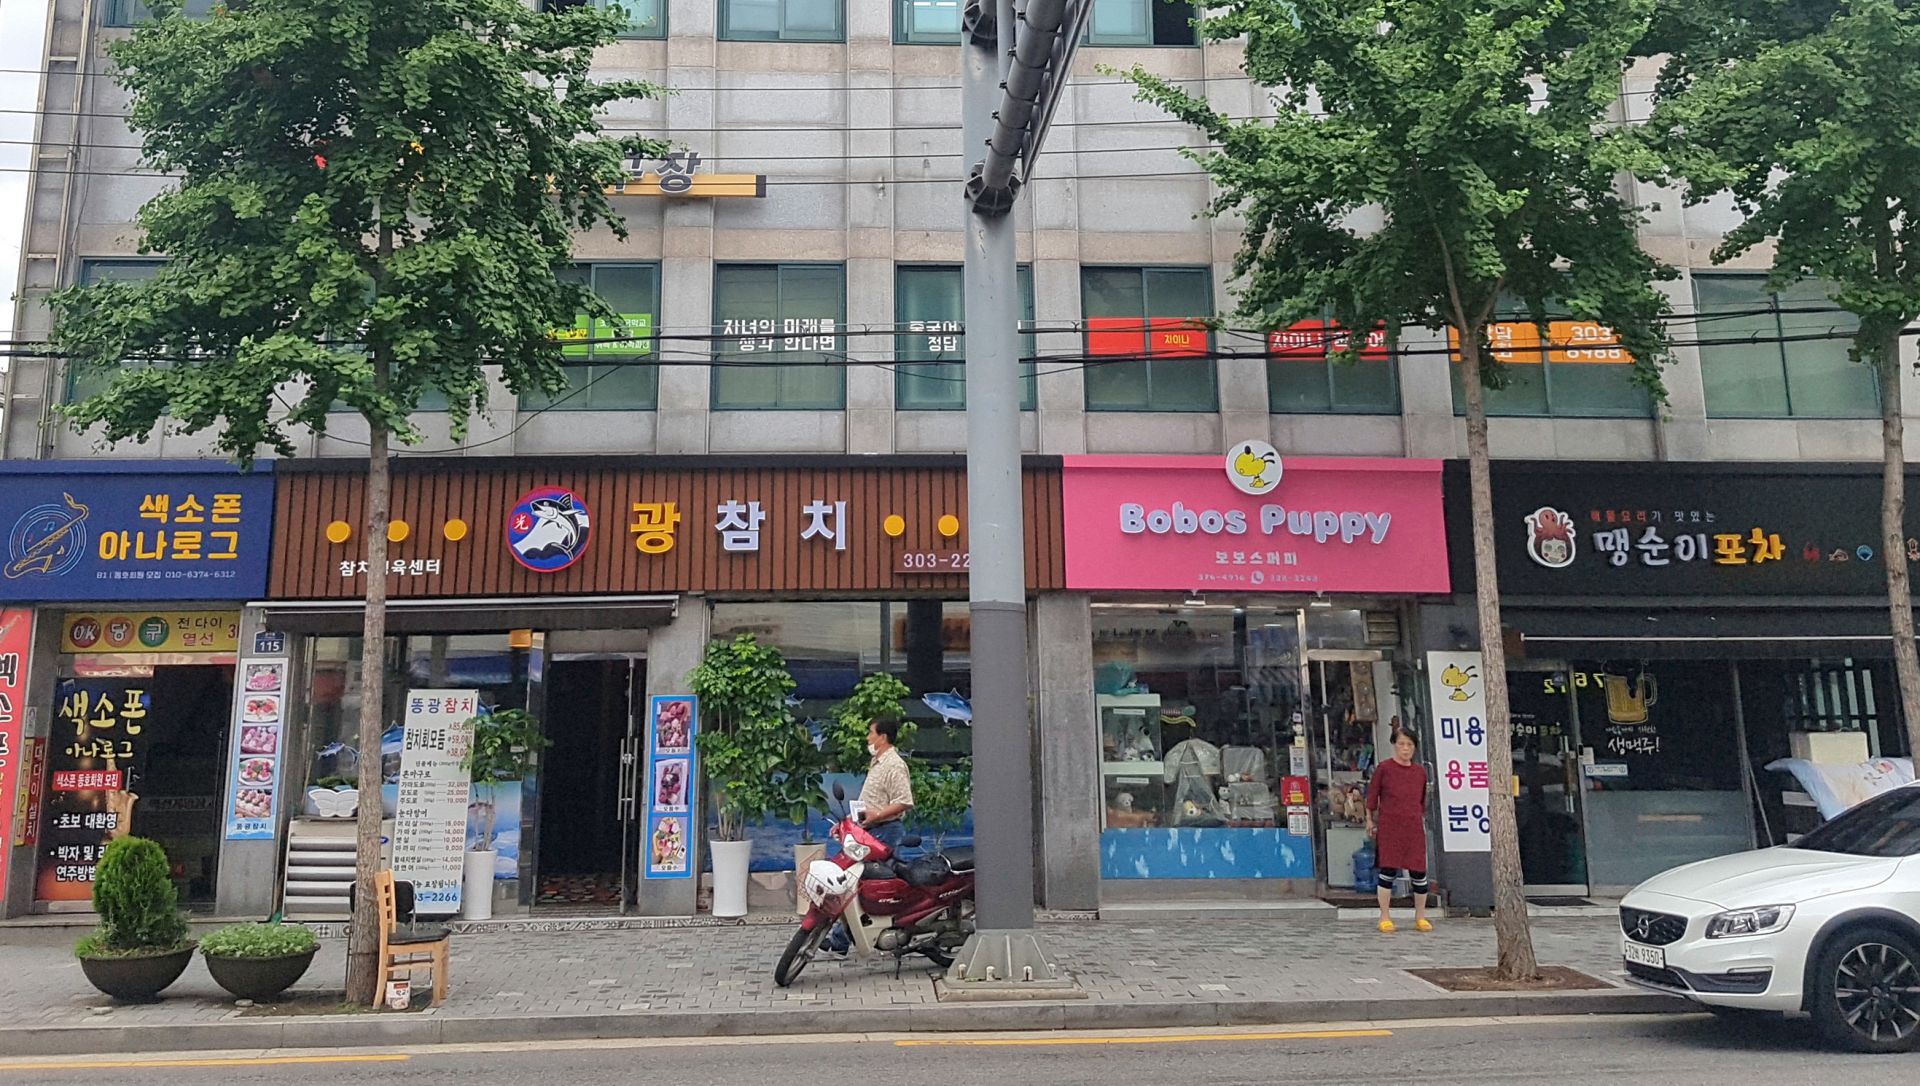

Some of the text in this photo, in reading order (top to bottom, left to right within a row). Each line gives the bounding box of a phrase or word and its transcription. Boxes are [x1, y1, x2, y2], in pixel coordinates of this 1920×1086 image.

[723, 318, 836, 335] 자녀의 미래를
[1571, 326, 1612, 341] 303
[739, 335, 835, 352] 생각 한다면
[928, 335, 957, 352] 정답
[138, 493, 242, 524] 색소폰
[1120, 501, 1392, 544] Bobos Puppy
[99, 530, 238, 561] 아나로그
[259, 641, 280, 652] 115
[58, 690, 147, 735] 색소폰
[406, 728, 446, 750] 참치회모듬
[1440, 716, 1485, 746] 미용
[65, 738, 134, 758] 아나로그
[1608, 736, 1660, 755] 생맥주!
[1445, 760, 1489, 790] 용품
[58, 813, 117, 829] 초보 대환영
[58, 845, 80, 861] 박자
